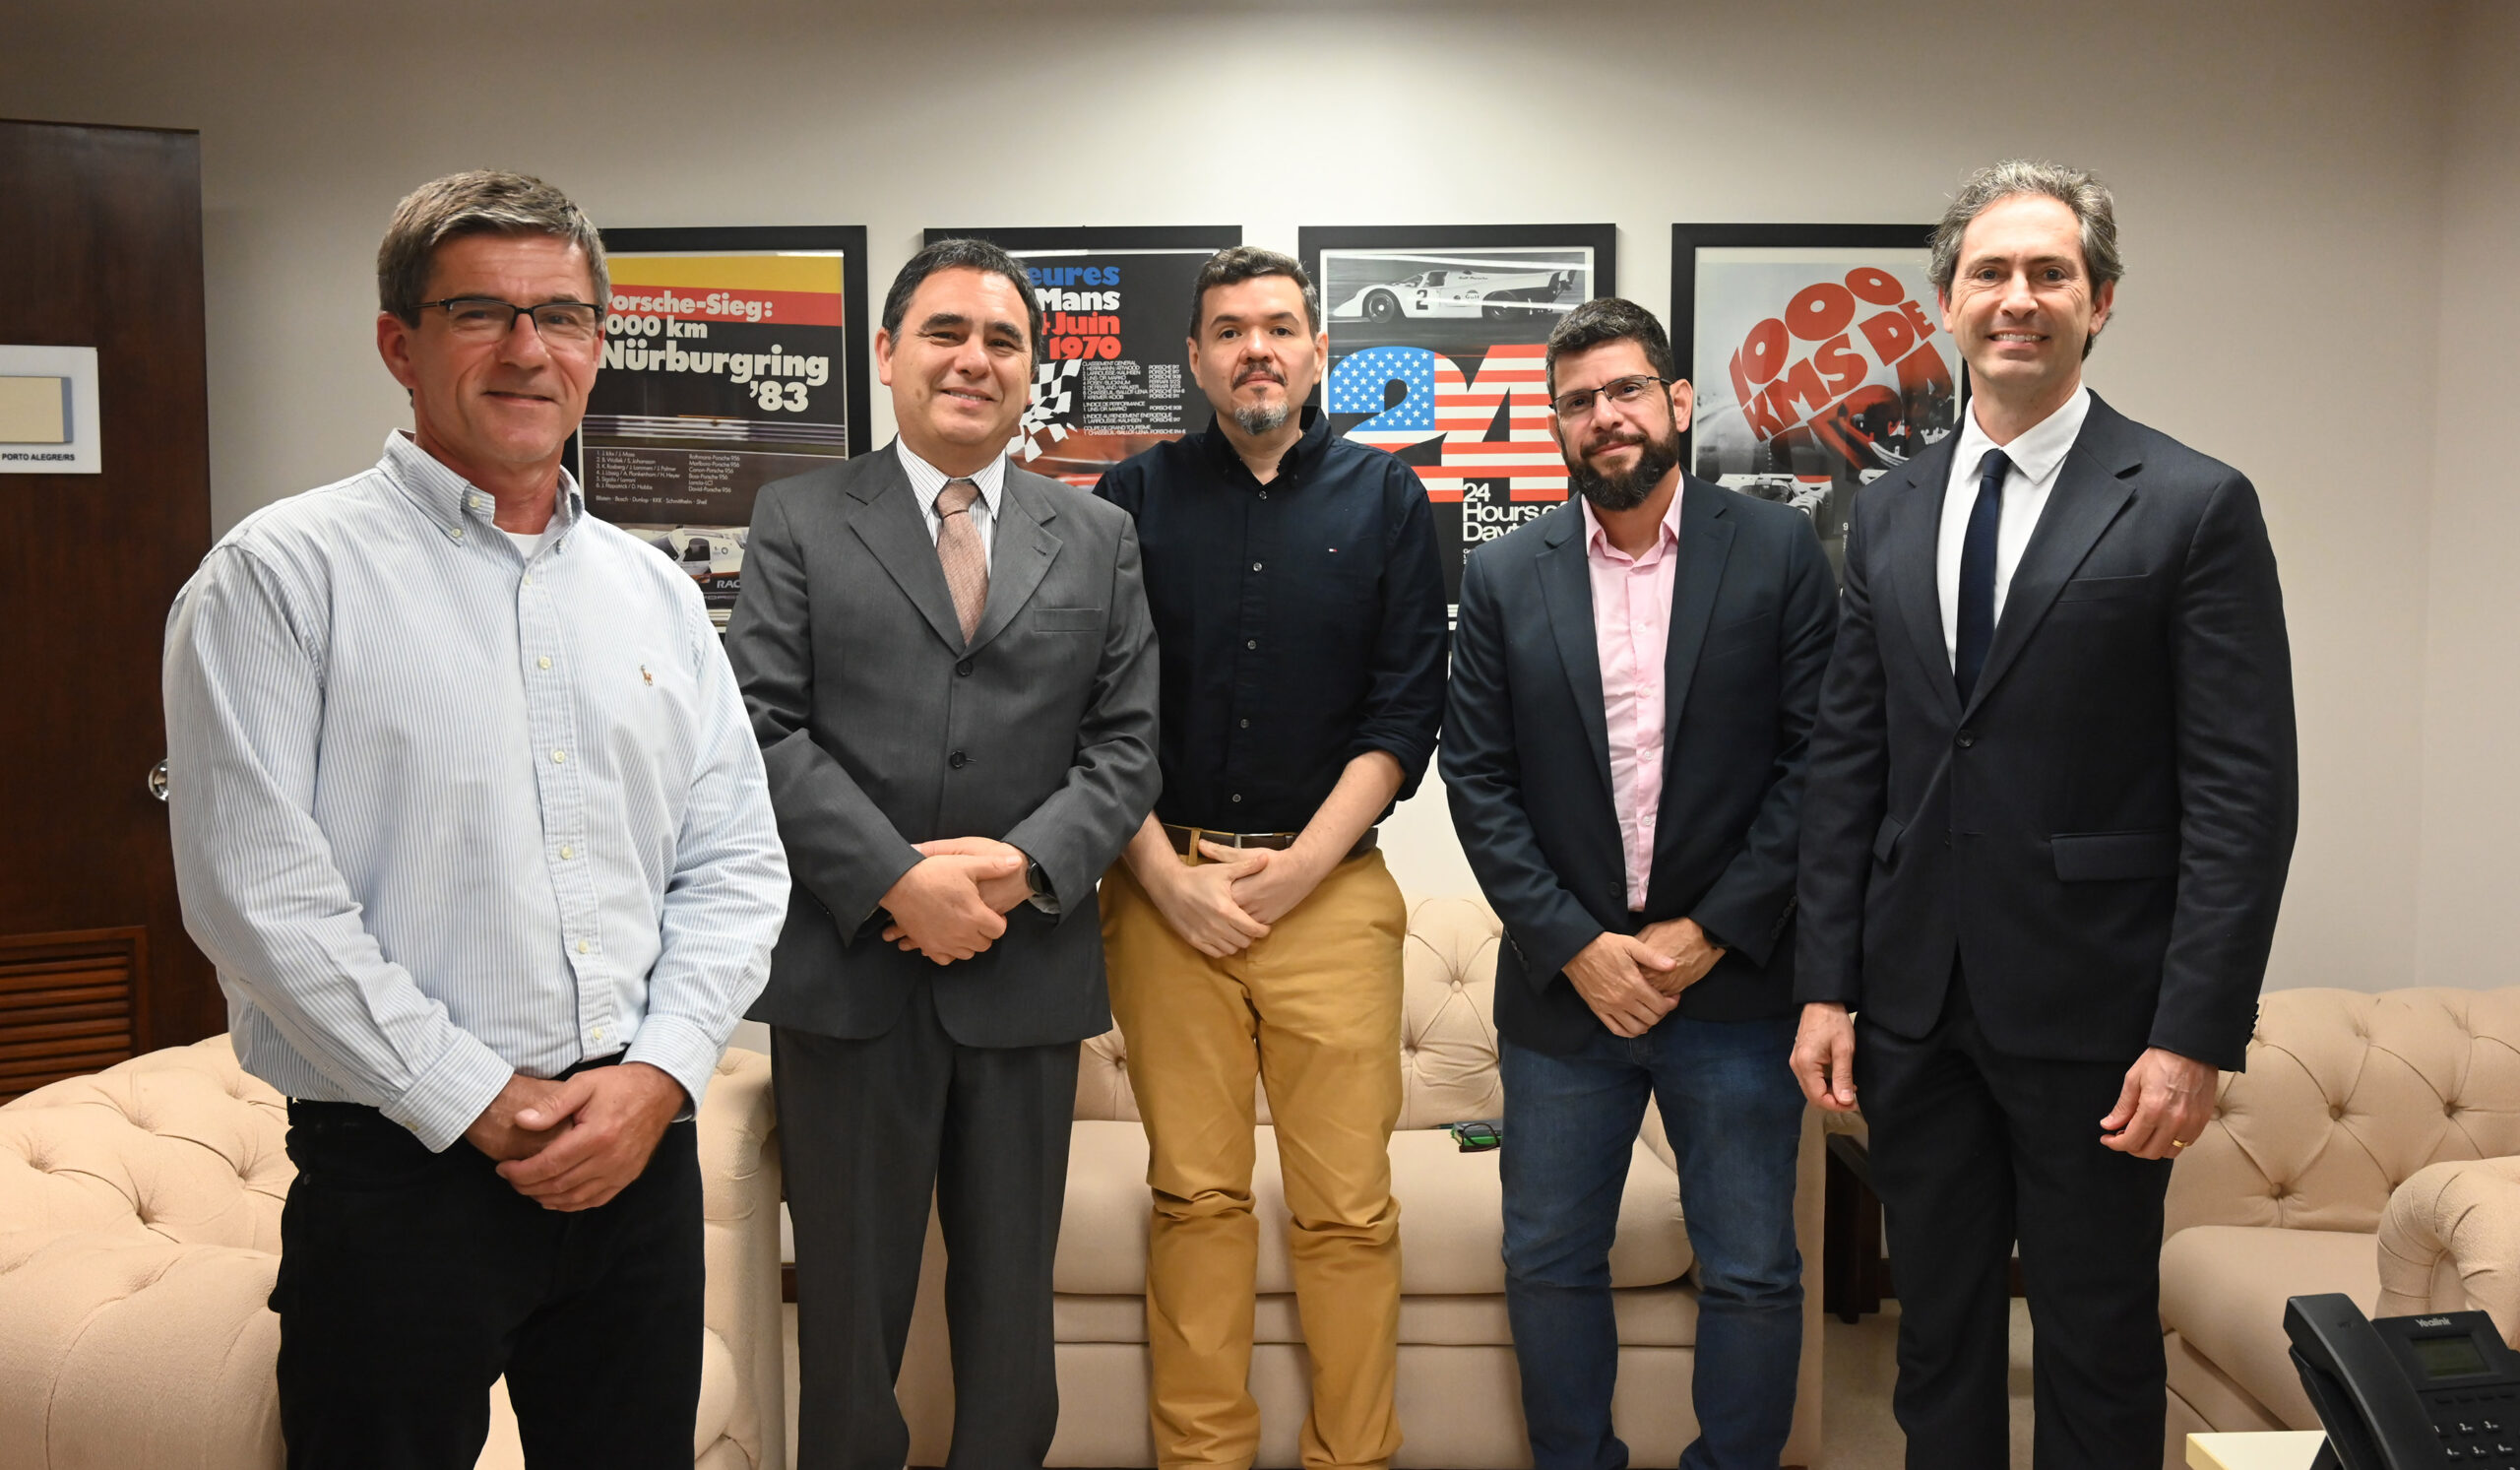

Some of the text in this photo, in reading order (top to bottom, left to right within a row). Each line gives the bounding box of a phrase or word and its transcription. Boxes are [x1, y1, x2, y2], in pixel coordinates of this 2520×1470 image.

[1028, 266, 1120, 286] eures
[1034, 288, 1120, 311] Mans
[605, 314, 708, 339] 000 km
[1051, 311, 1120, 335] Juin
[1049, 336, 1121, 359] 1970
[1729, 267, 1905, 407] 1000
[598, 338, 829, 386] Nürburgring
[1742, 299, 1936, 442] KMS DE
[749, 380, 808, 412] '83
[1463, 482, 1490, 502] 24
[1463, 501, 1540, 522] Hours
[1463, 522, 1521, 542] Day
[717, 580, 740, 589] RAC
[2416, 1317, 2452, 1327] Yealink
